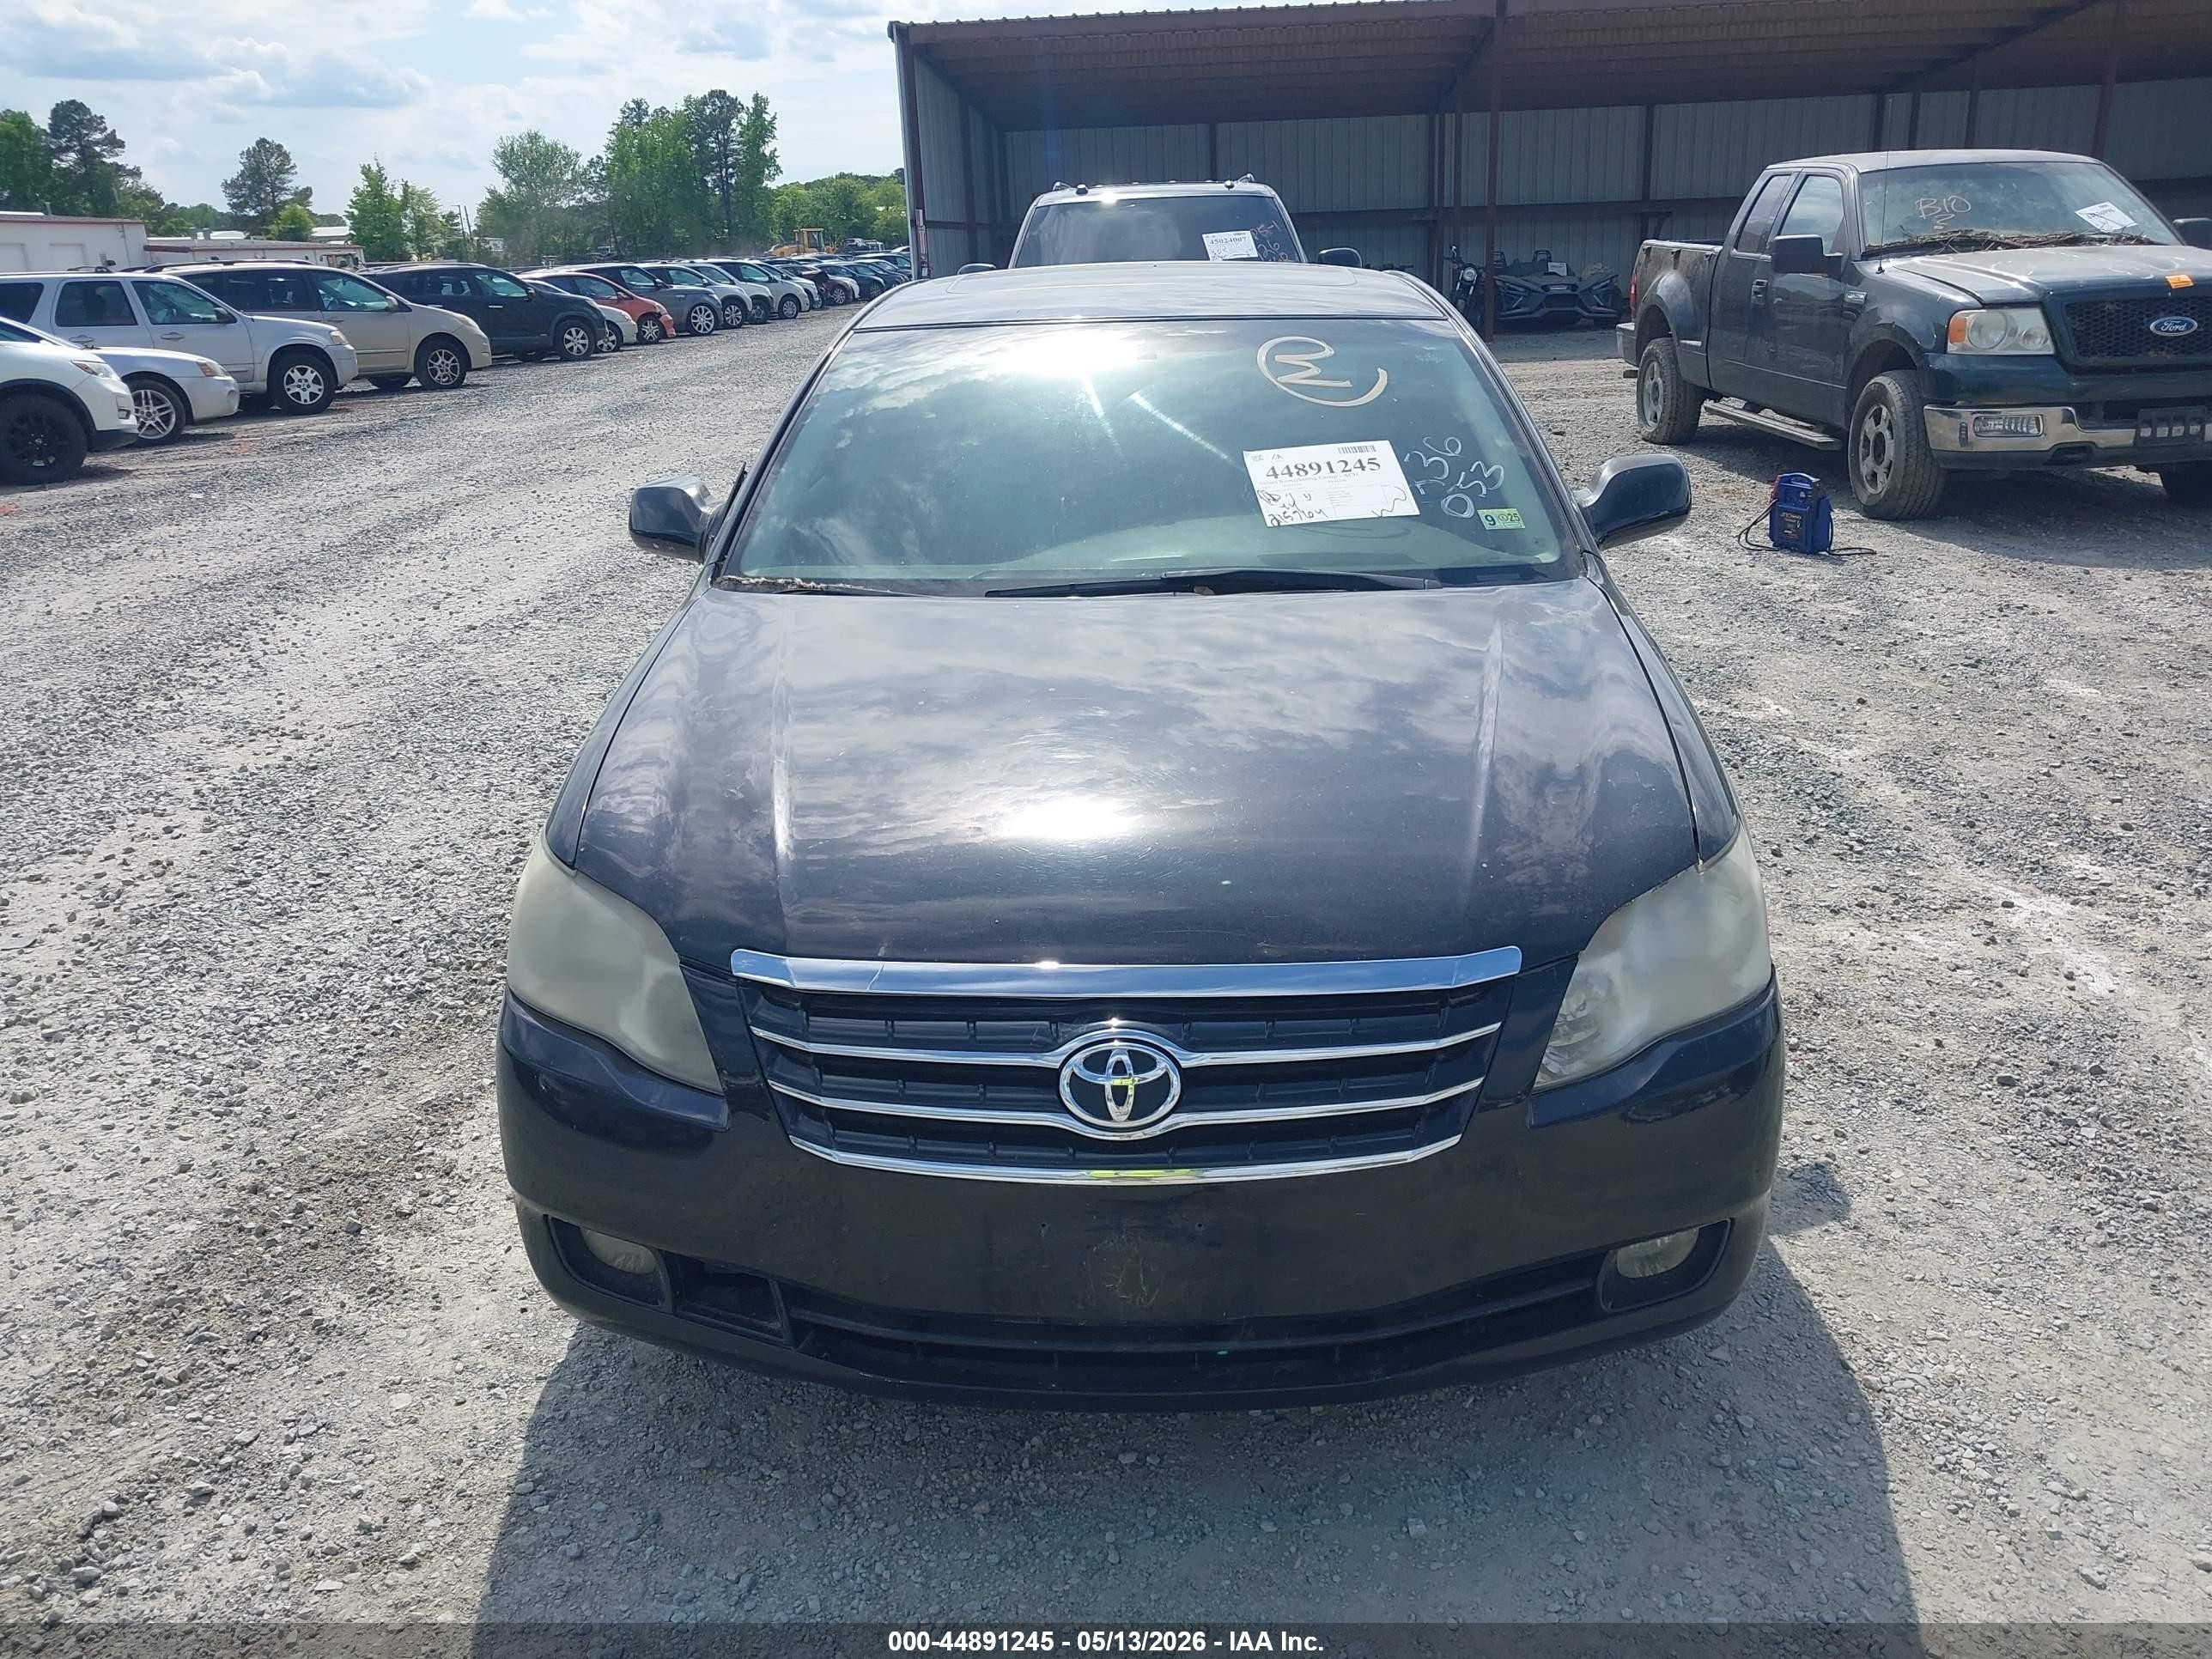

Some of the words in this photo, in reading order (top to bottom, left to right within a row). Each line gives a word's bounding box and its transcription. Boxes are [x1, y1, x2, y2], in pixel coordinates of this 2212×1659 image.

[2160, 320, 2187, 331] Ford
[1265, 457, 1382, 480] 44891245
[1485, 514, 1497, 526] 9
[1507, 513, 1521, 522] 25
